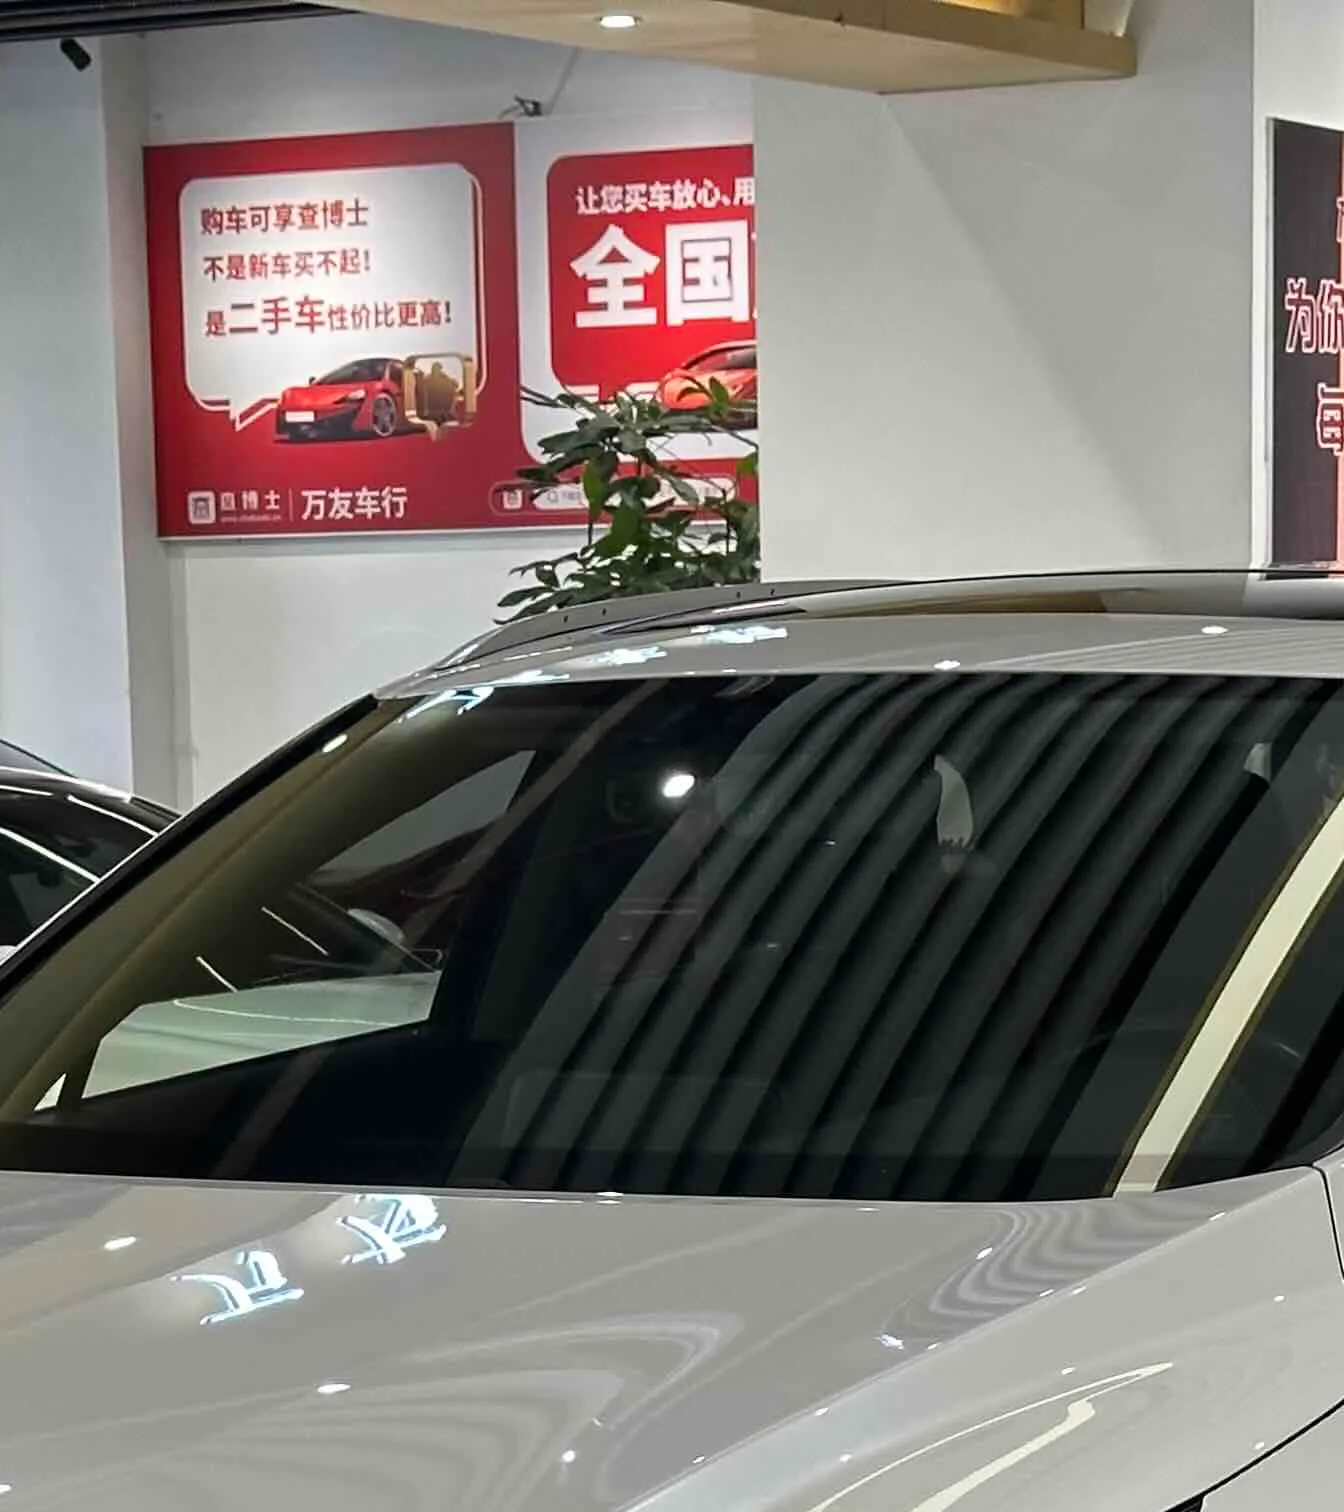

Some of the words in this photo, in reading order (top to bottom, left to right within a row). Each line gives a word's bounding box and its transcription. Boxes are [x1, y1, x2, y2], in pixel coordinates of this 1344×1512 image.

[201, 198, 369, 235] 购车可享查博士
[569, 219, 756, 328] 全国
[301, 485, 408, 520] 万友车行
